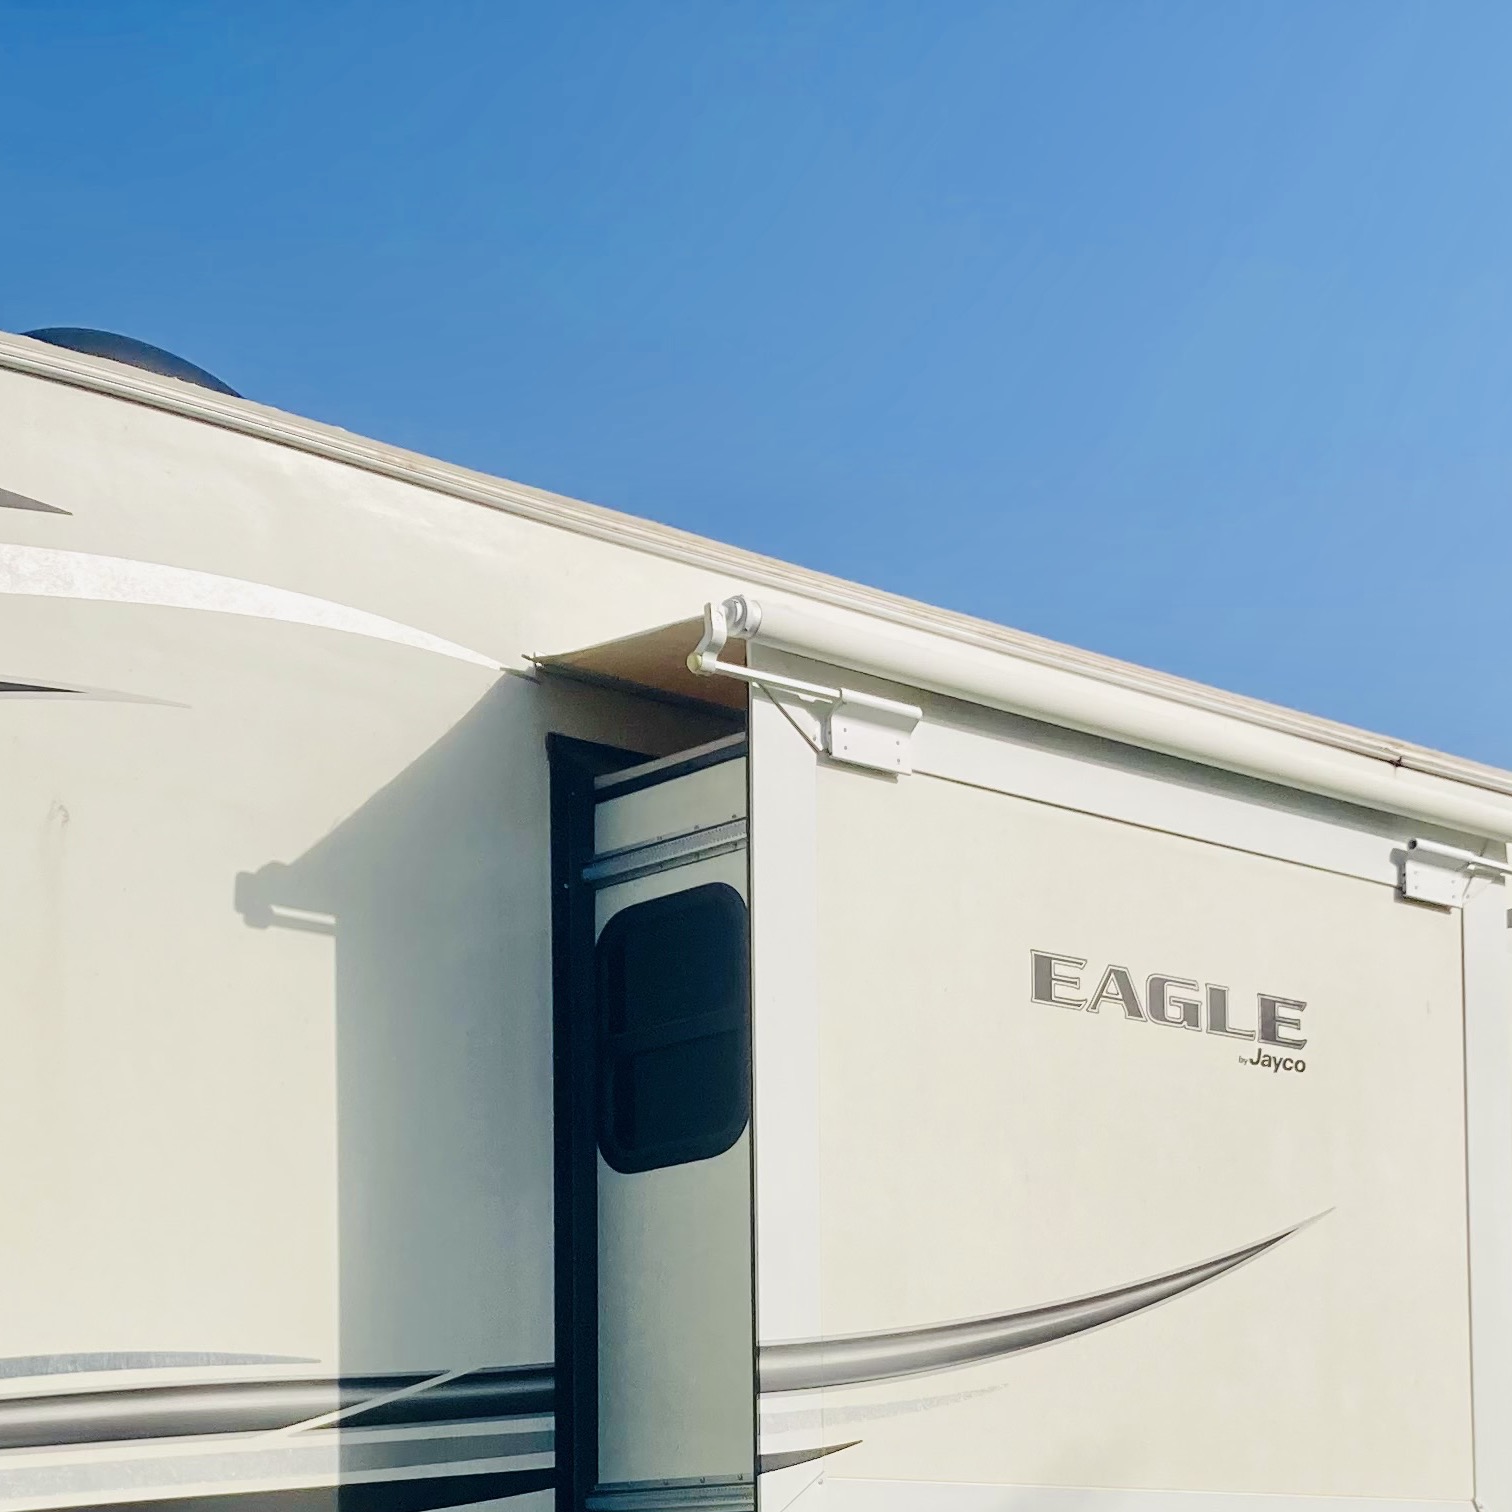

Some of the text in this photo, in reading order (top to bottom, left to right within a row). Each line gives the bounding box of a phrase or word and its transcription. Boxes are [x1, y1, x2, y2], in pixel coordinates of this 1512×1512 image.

[1030, 949, 1307, 1050] EAGLE
[1238, 1047, 1306, 1073] by Jayco
